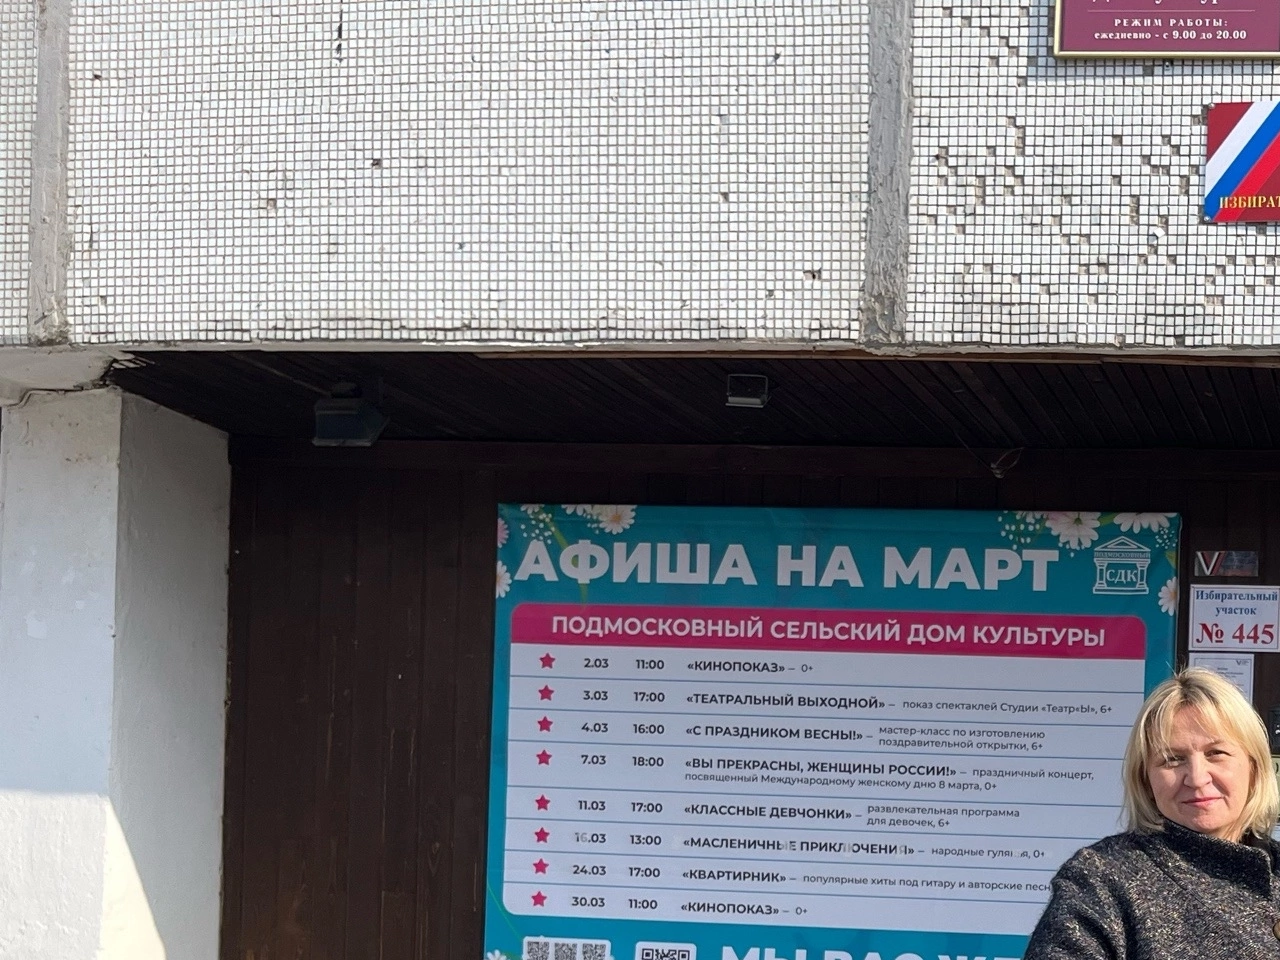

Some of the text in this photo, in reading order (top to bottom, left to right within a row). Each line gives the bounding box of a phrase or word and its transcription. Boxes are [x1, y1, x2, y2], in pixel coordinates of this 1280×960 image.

[1114, 18, 1228, 27] РЕЖИМ РАБОТЫ:
[1094, 31, 1151, 40] ежедневно
[1172, 30, 1196, 40] 9.00
[1200, 32, 1213, 40] до
[1216, 30, 1247, 40] 20.00
[514, 539, 1059, 592] АФИША НА МАРТ
[1106, 569, 1138, 585] СДК
[1196, 590, 1278, 602] Избирательный
[1215, 606, 1257, 616] участок
[552, 615, 1106, 647] ПОДМОСКОВНЫЙ СЕЛЬСКИЙ ДОМ КУЛЬТУРЫ
[1196, 623, 1274, 645] № 445
[583, 658, 814, 673] 2.03 11:00 «КИНОПОКАЗ» 0+
[583, 690, 609, 701] 3.03
[633, 691, 665, 702] 17:00
[686, 693, 794, 707] «ТЕАТРАЛЬНЫЙ
[798, 695, 885, 710] ВЫХОДНОЙ»
[903, 700, 933, 710] показ
[936, 701, 997, 712] спектаклей
[1000, 703, 1039, 714] Студии
[1100, 705, 1113, 714] 6+
[581, 722, 863, 741] 4.03 16:00 «С ПРАЗДНИКОМ ВЕСНЫ!»
[879, 727, 1045, 739] мастер-класс по изготовлению
[879, 738, 1043, 752] поздравительной открытки, 6+
[581, 755, 1094, 781] 7.03 18:00 «ВЫ ПРЕКРАСНЫ, ЖЕНЩИНЫ РОССИИ!» праздничный концерт,
[685, 772, 997, 792] посвященный Международному женскому дню 8 марта, 0+
[578, 800, 852, 820] 11.03 17:00 «КЛАССНЫЕ ДЕВЧОНКИ»
[867, 804, 1020, 819] развлекательная программа
[867, 817, 950, 829] для девочек, 6+
[575, 832, 607, 843] 16.03
[630, 834, 662, 846] 13:00
[931, 848, 984, 858] народные
[987, 849, 1031, 860] гуляя,
[1033, 850, 1045, 859] 0+
[572, 865, 1051, 892] 24.03 17:00 «КВАРТИРНИК» популярные хиты под гитару и авторские песн
[572, 897, 808, 916] 30.03 11:00 «КИНОПОКАЗ» 0+
